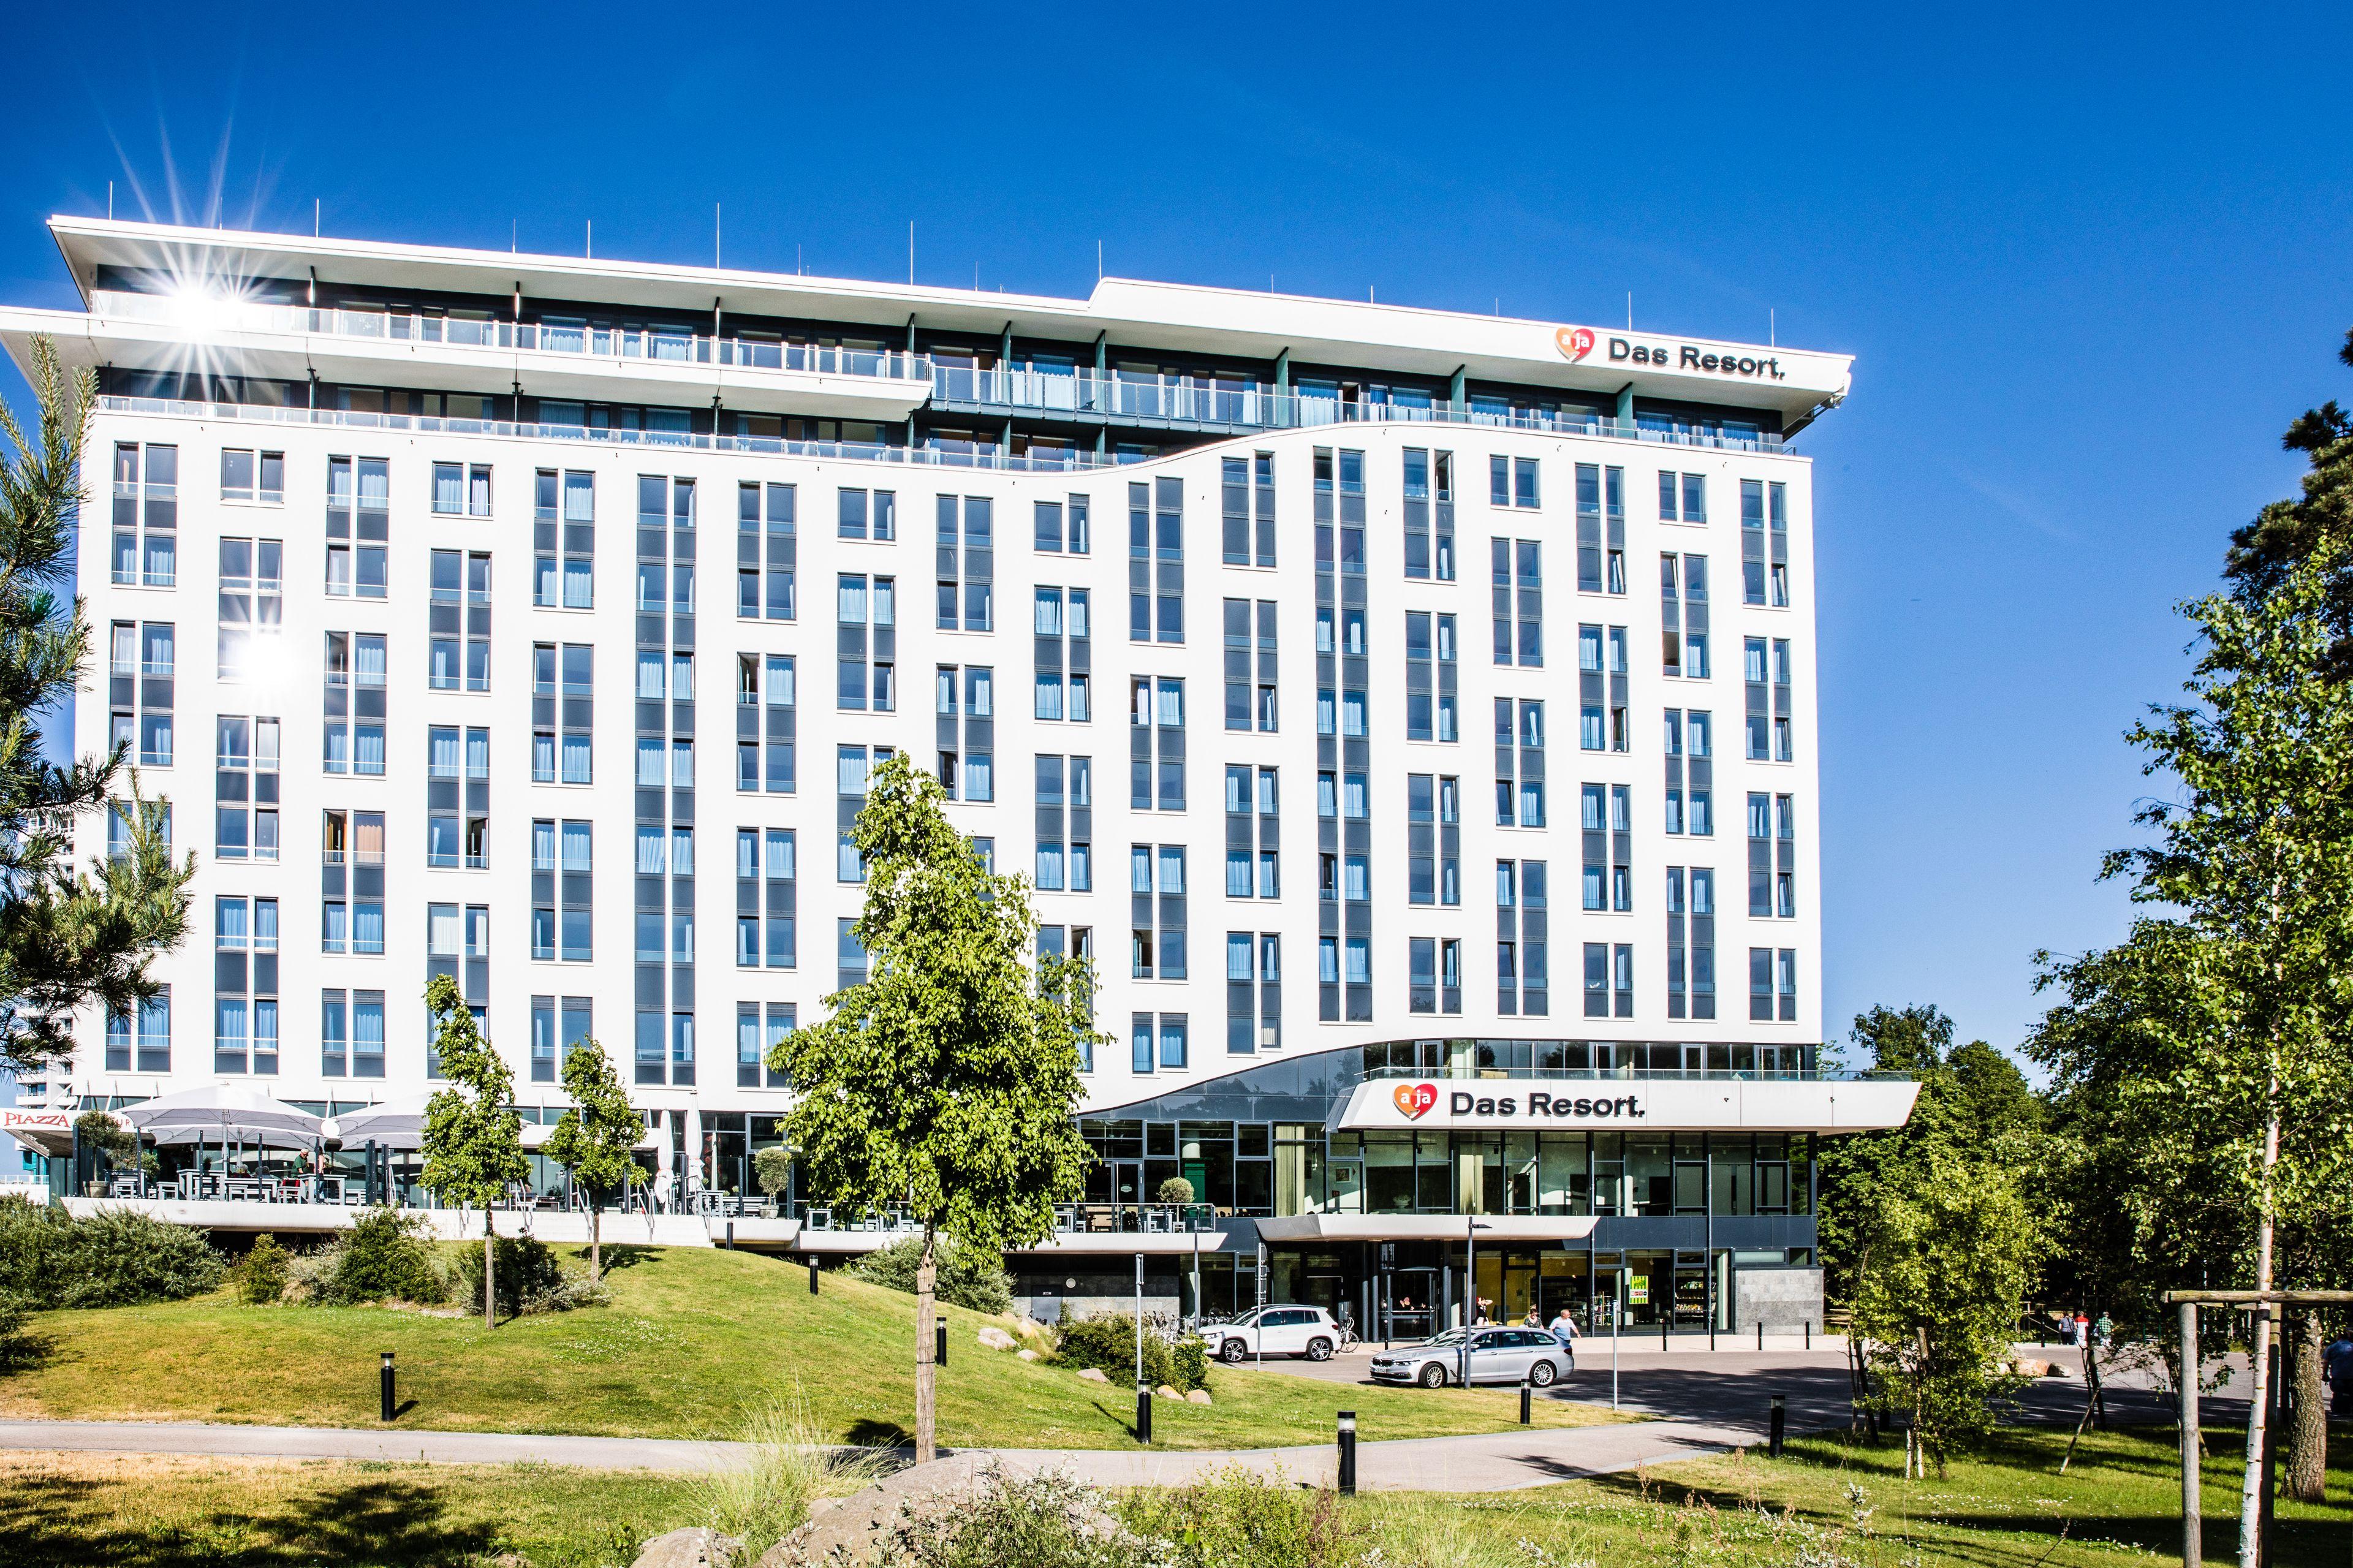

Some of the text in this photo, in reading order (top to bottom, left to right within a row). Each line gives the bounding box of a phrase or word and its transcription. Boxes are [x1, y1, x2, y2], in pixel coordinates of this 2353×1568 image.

[1608, 338, 1786, 379] Das Resort.
[1450, 1092, 1645, 1117] Das Resort.
[4, 1112, 71, 1128] PIAZZA
